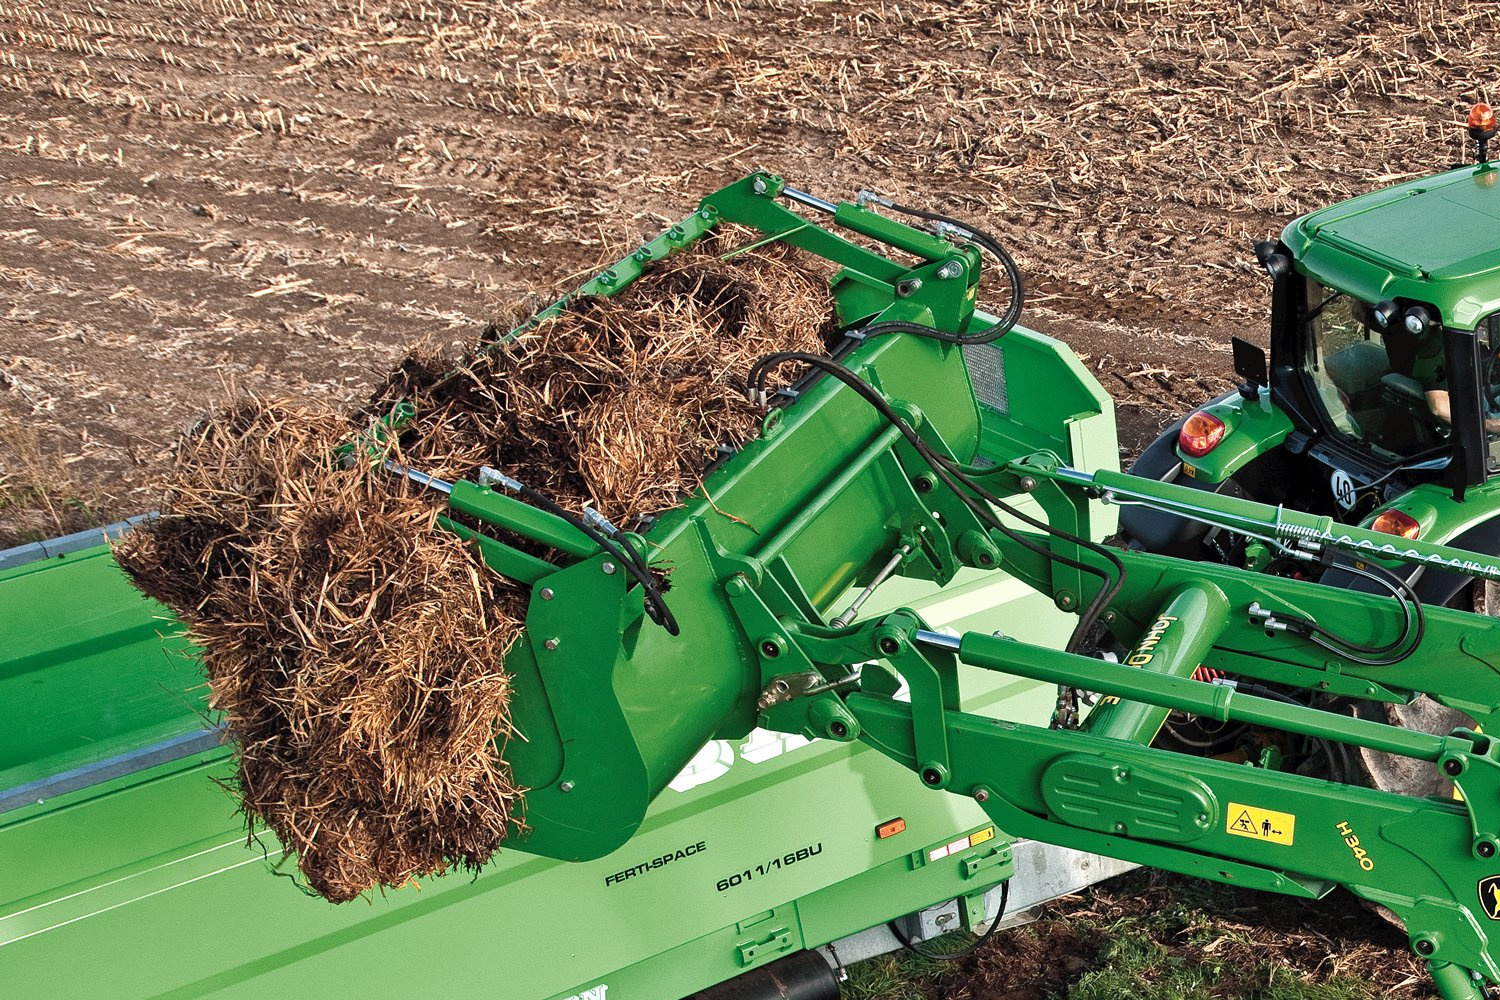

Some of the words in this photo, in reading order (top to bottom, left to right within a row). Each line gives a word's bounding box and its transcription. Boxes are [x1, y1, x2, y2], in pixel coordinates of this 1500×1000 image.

[1336, 476, 1352, 505] 40
[1139, 613, 1179, 652] JOHN
[604, 841, 707, 887] FERTI-SPACE
[716, 842, 823, 892] 6011/16BU
[1335, 820, 1375, 872] H340
